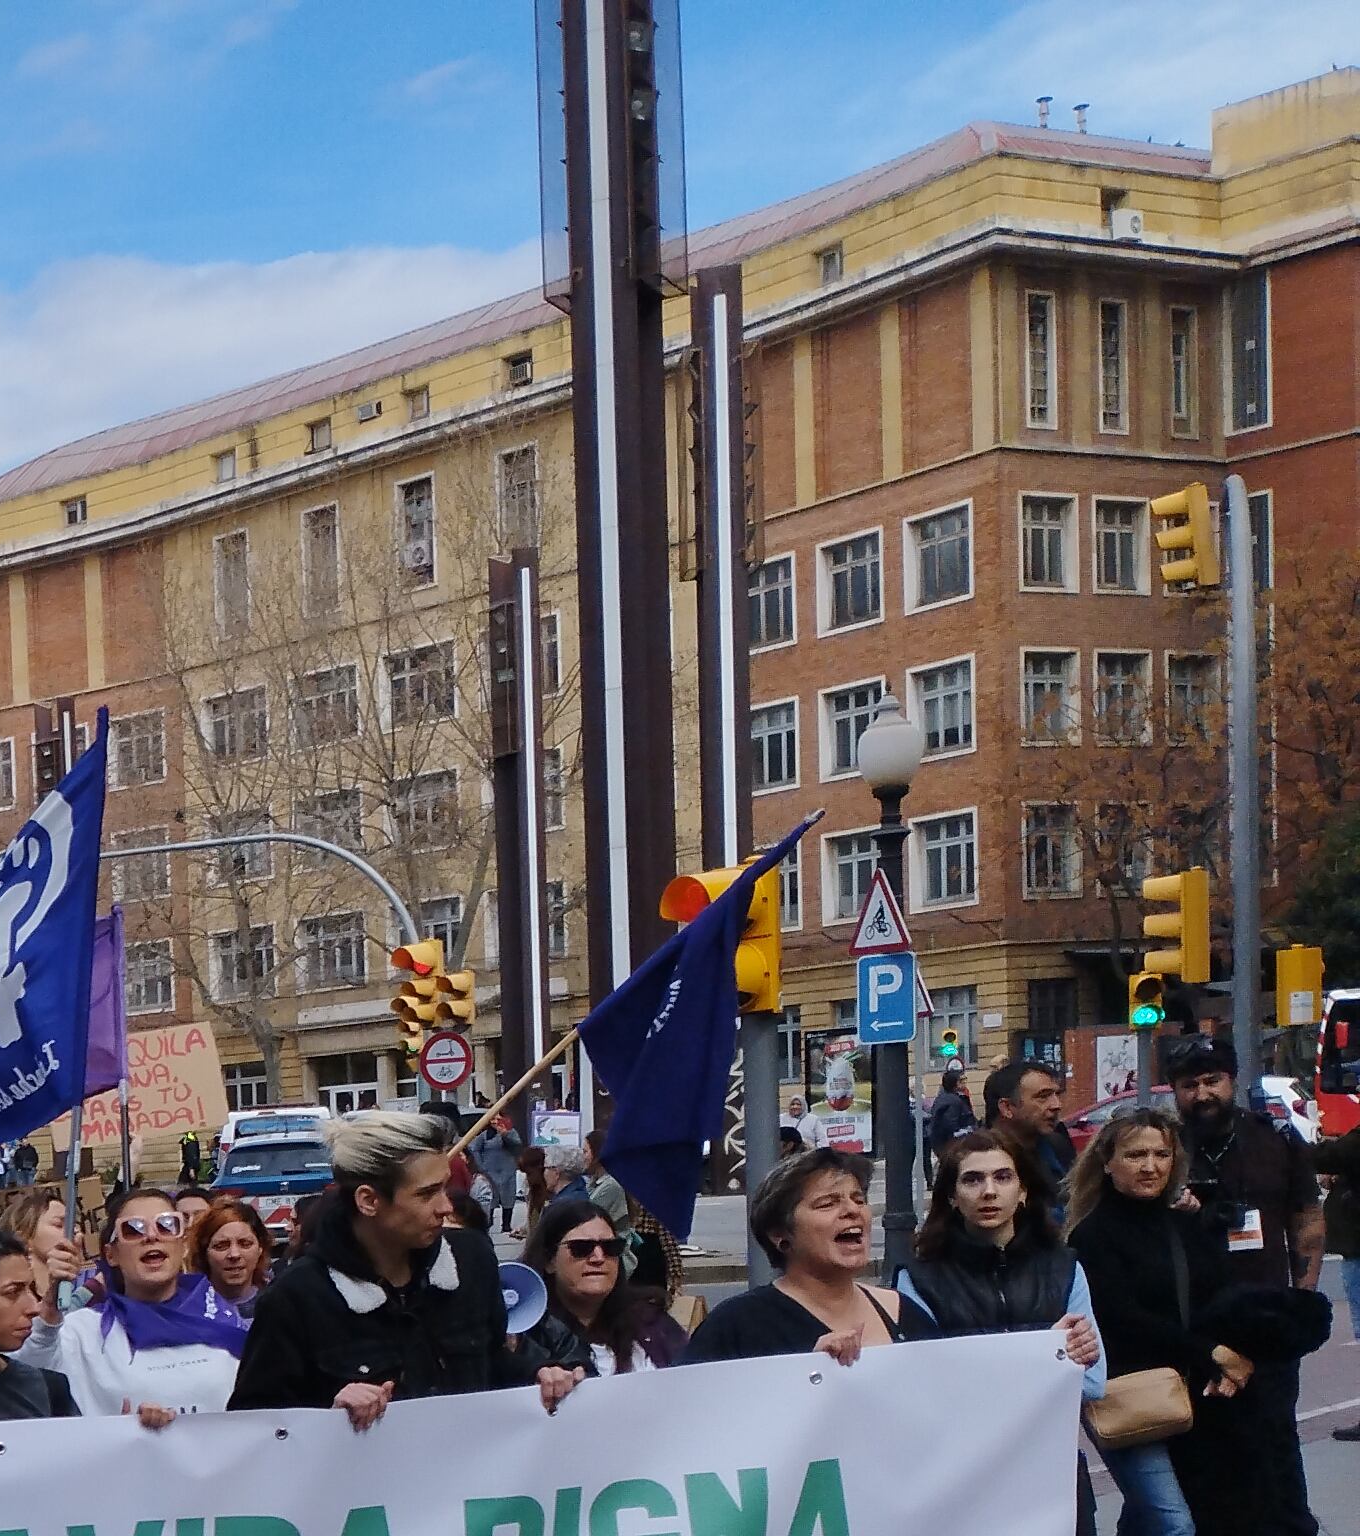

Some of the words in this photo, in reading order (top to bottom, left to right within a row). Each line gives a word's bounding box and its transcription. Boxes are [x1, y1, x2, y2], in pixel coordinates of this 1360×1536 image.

[868, 964, 903, 1013] P
[128, 1028, 207, 1068] QUILA
[81, 1097, 207, 1145] MAADA!
